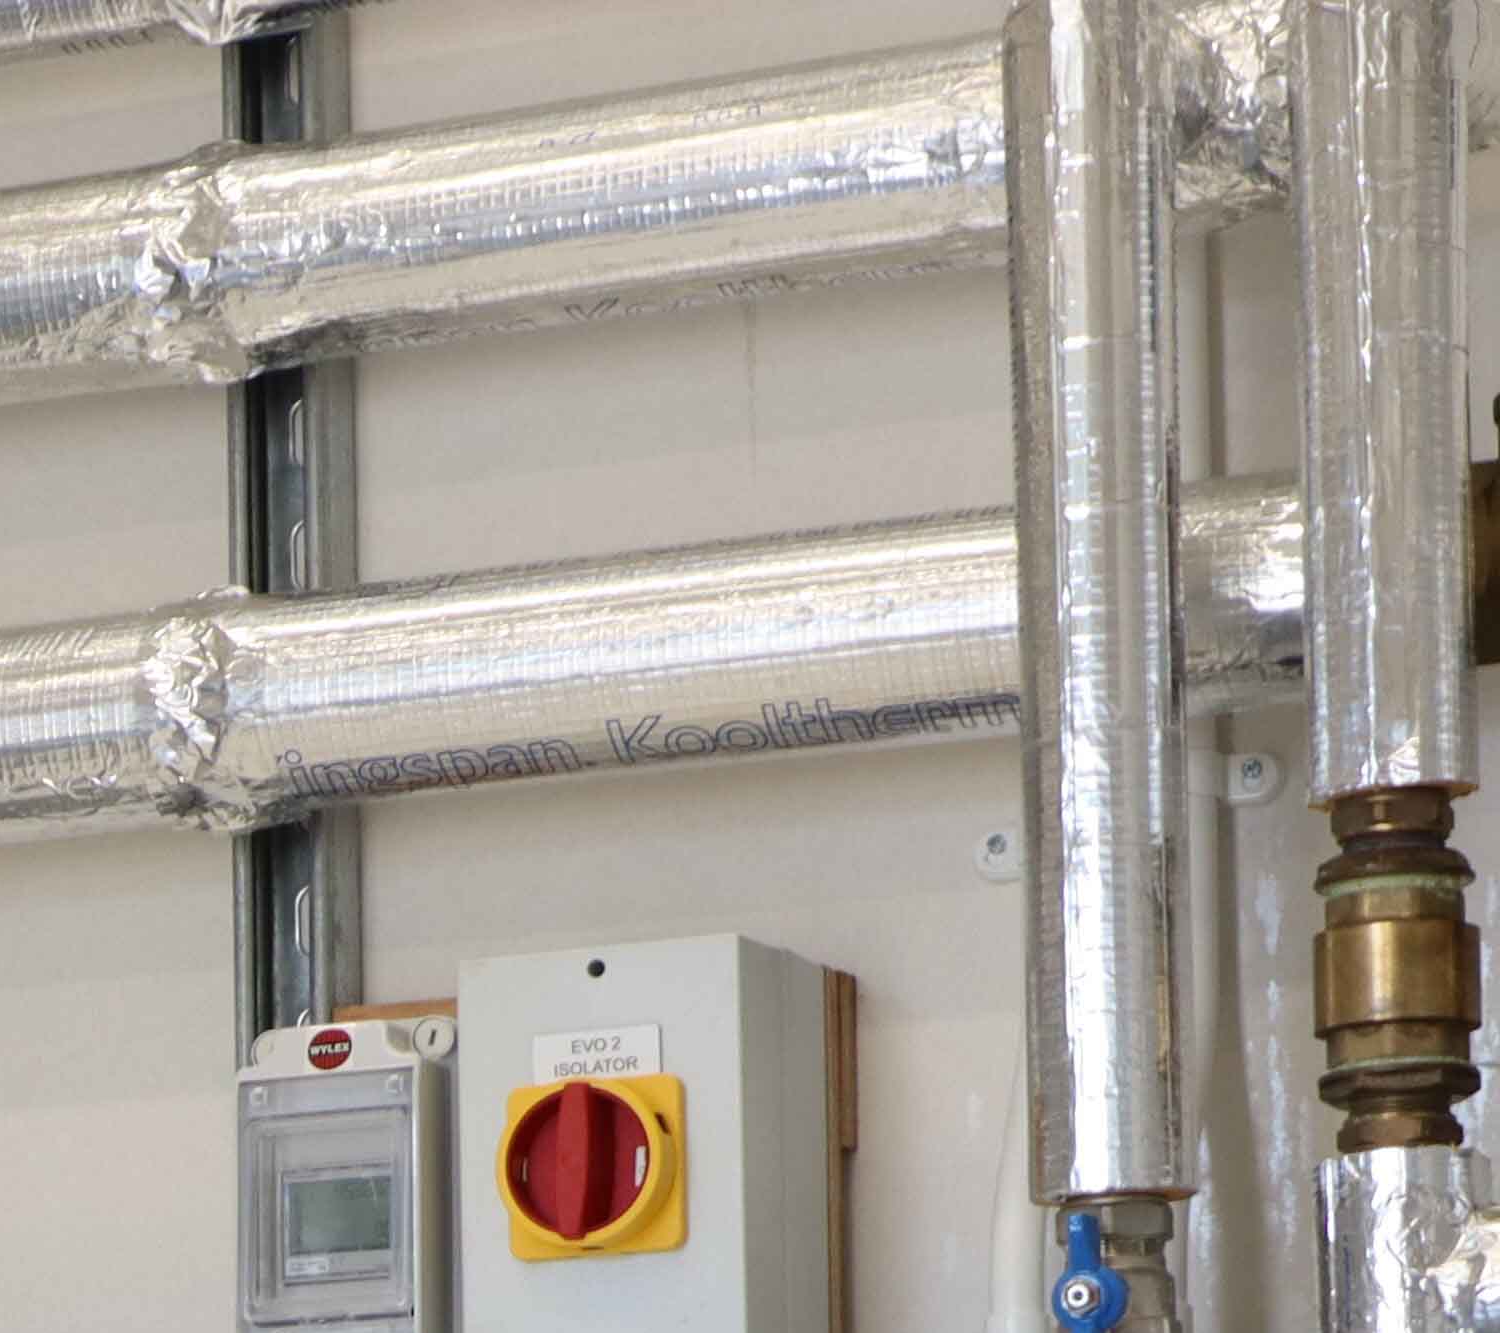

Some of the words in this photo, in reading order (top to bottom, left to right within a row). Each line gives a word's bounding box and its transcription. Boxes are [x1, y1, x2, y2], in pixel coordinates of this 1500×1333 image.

[308, 1040, 351, 1057] WYLEX
[571, 1037, 606, 1054] EVO
[610, 1036, 622, 1052] 2
[553, 1056, 639, 1078] ISOLATOR
